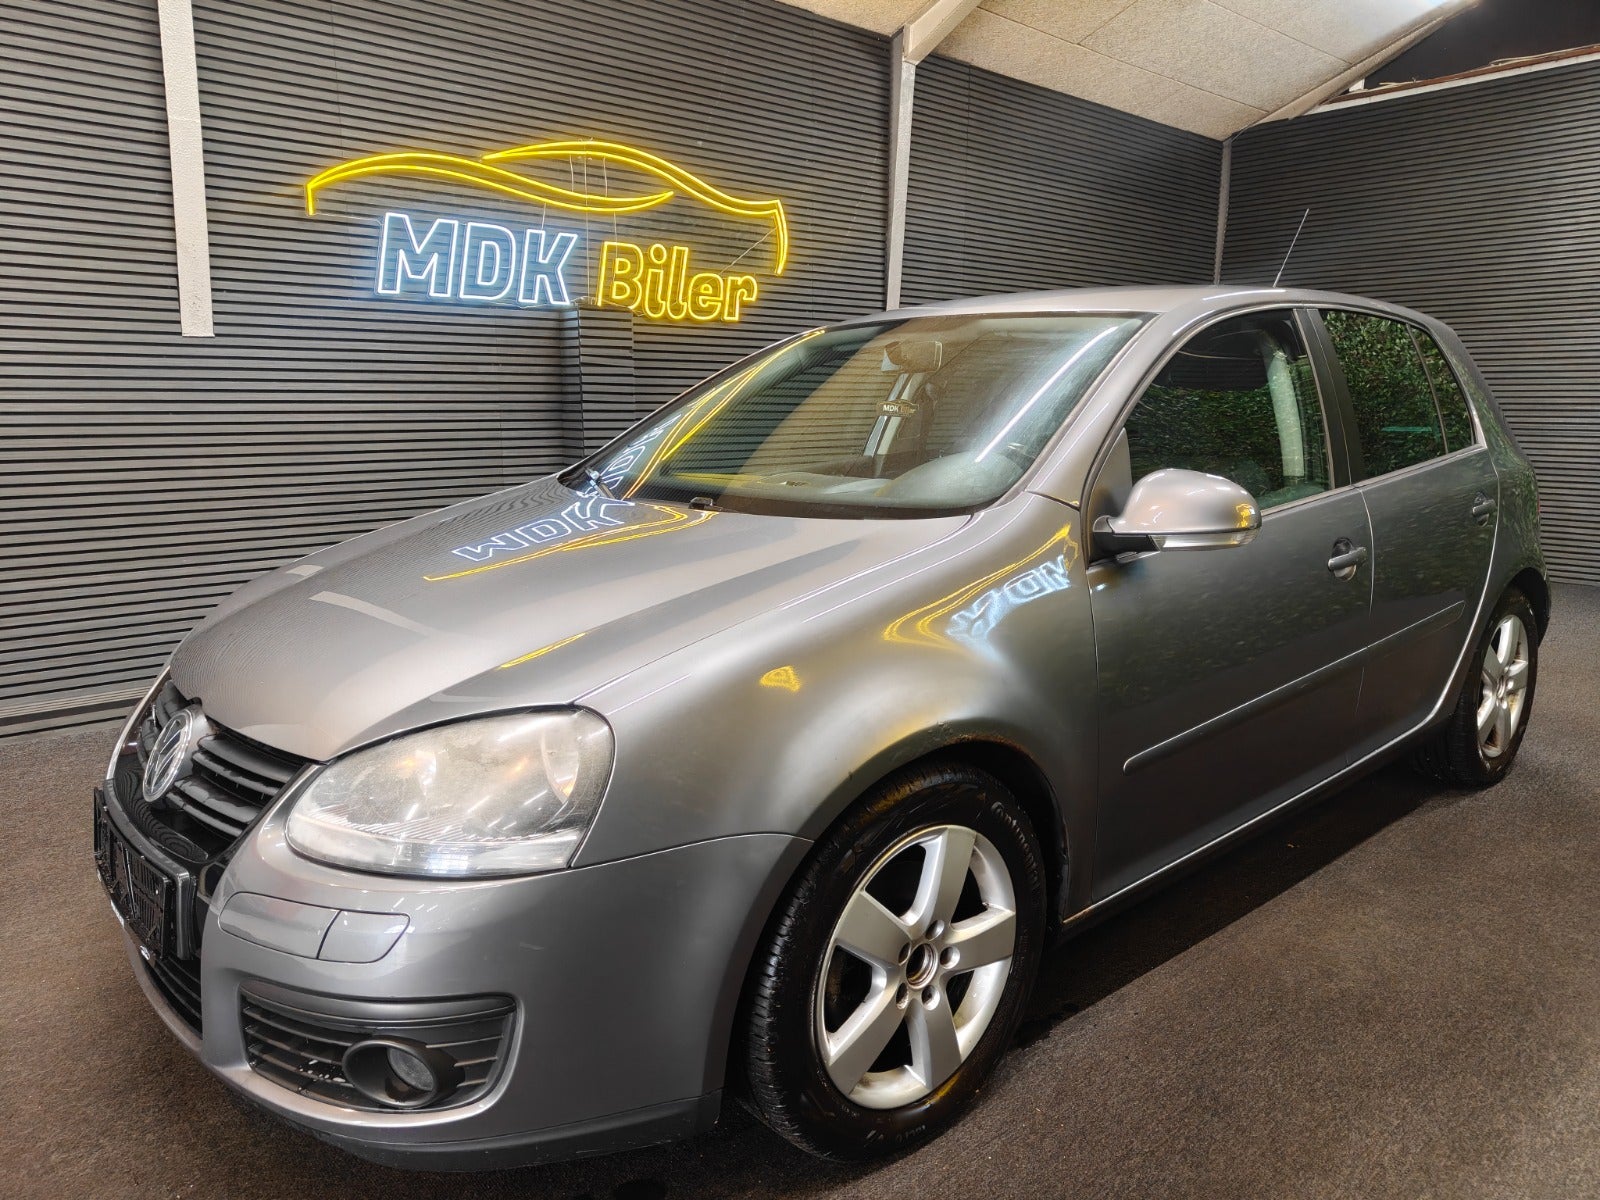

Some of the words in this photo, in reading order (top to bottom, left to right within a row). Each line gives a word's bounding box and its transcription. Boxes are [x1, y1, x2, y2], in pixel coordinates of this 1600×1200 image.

[375, 210, 579, 306] MDK
[595, 239, 759, 322] Biler
[882, 403, 899, 413] MDK
